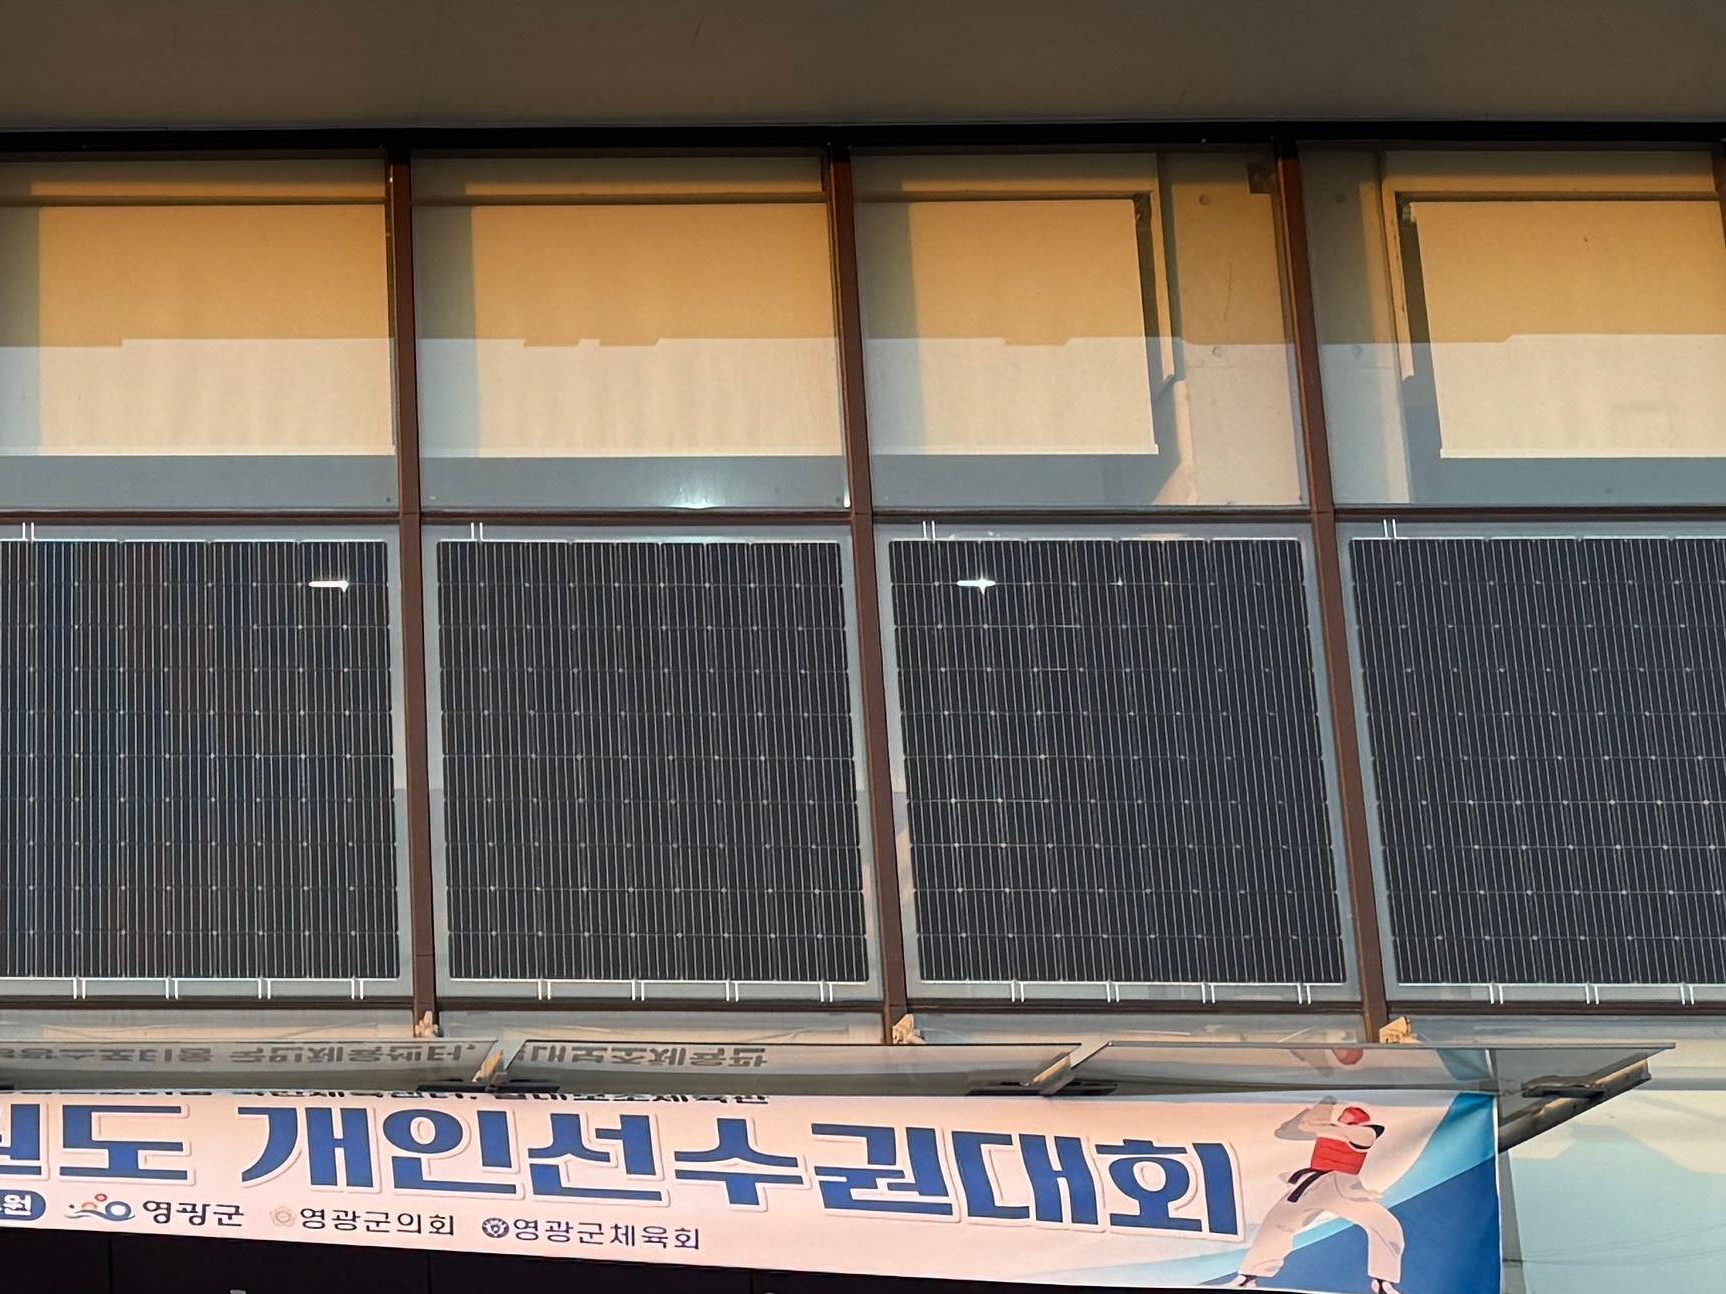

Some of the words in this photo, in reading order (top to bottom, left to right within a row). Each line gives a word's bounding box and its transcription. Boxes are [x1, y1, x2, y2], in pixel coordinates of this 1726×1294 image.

[238, 1106, 1239, 1236] 개인선수권대회
[142, 1199, 245, 1227] 영광군
[299, 1206, 456, 1237] 영광군의회
[513, 1217, 701, 1250] 영광군체육회
